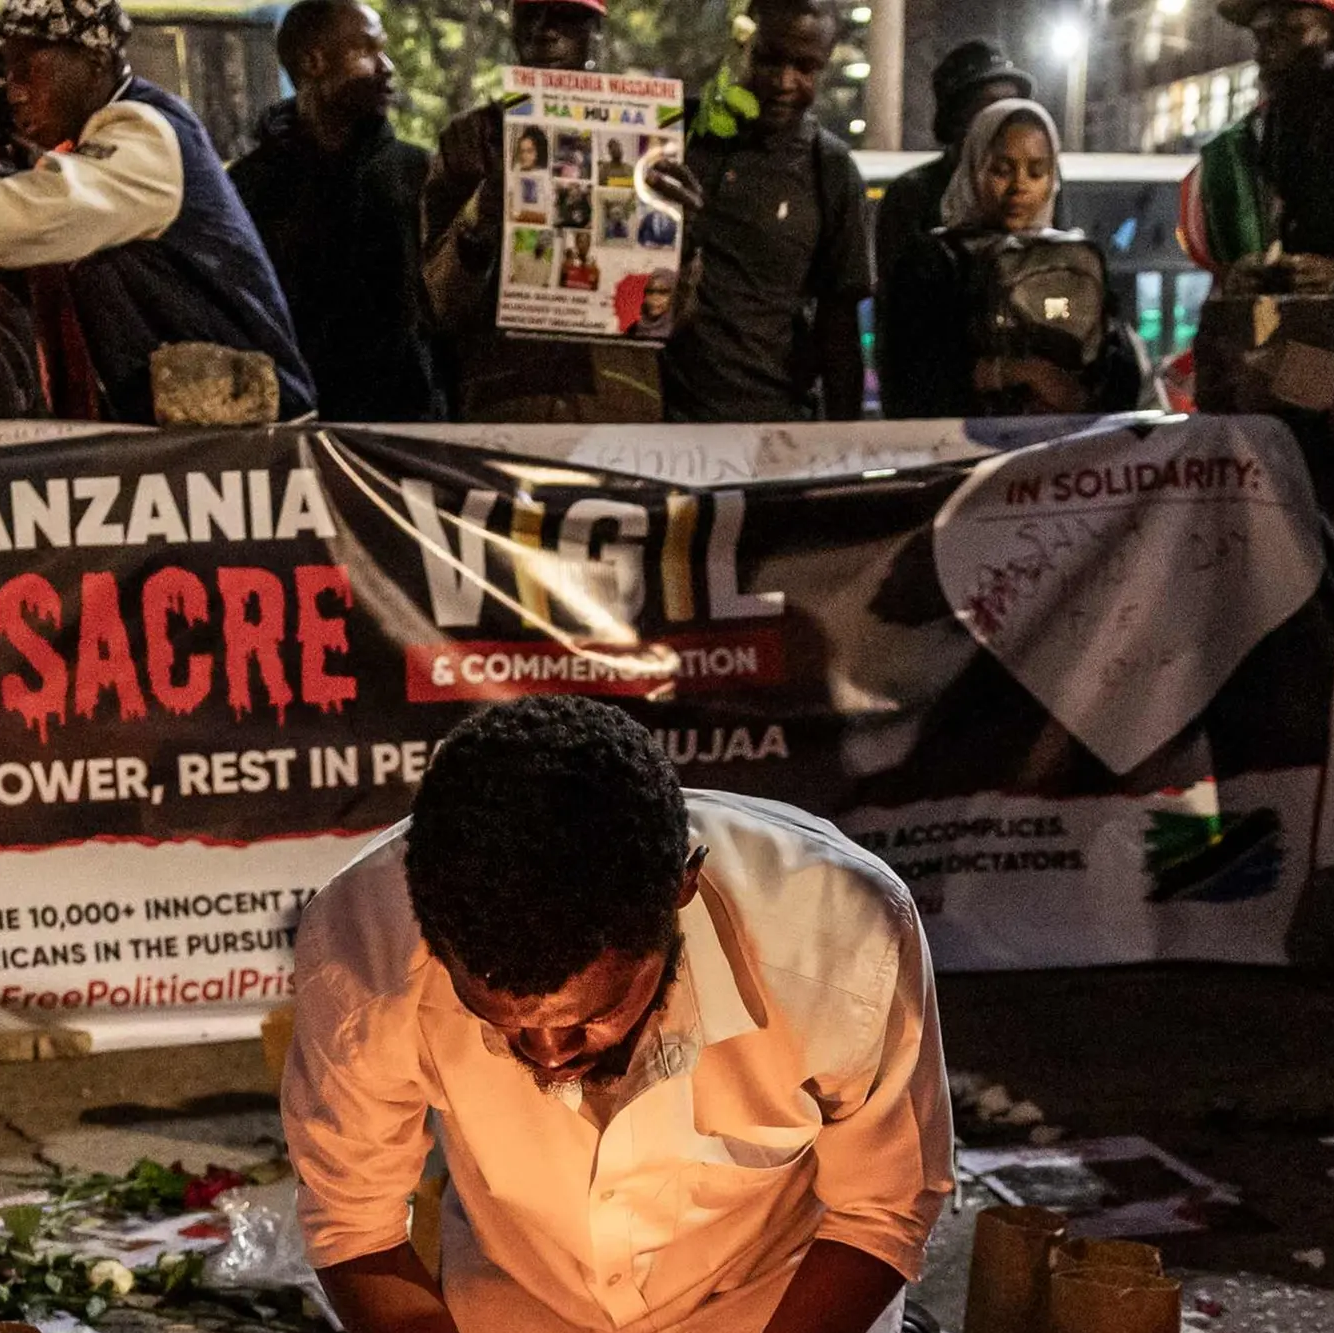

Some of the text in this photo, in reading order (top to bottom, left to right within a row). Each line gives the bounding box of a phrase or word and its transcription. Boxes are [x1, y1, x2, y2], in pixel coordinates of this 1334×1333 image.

[1006, 457, 1263, 507] IN SOLIDARITY:
[431, 656, 455, 686] &
[178, 750, 296, 797] REST
[309, 746, 358, 789] IN
[29, 902, 135, 931] 10,000+
[145, 890, 283, 922] INNOCENT
[95, 941, 122, 965] IN
[129, 936, 179, 962] THE
[187, 925, 295, 957] PURSUIT
